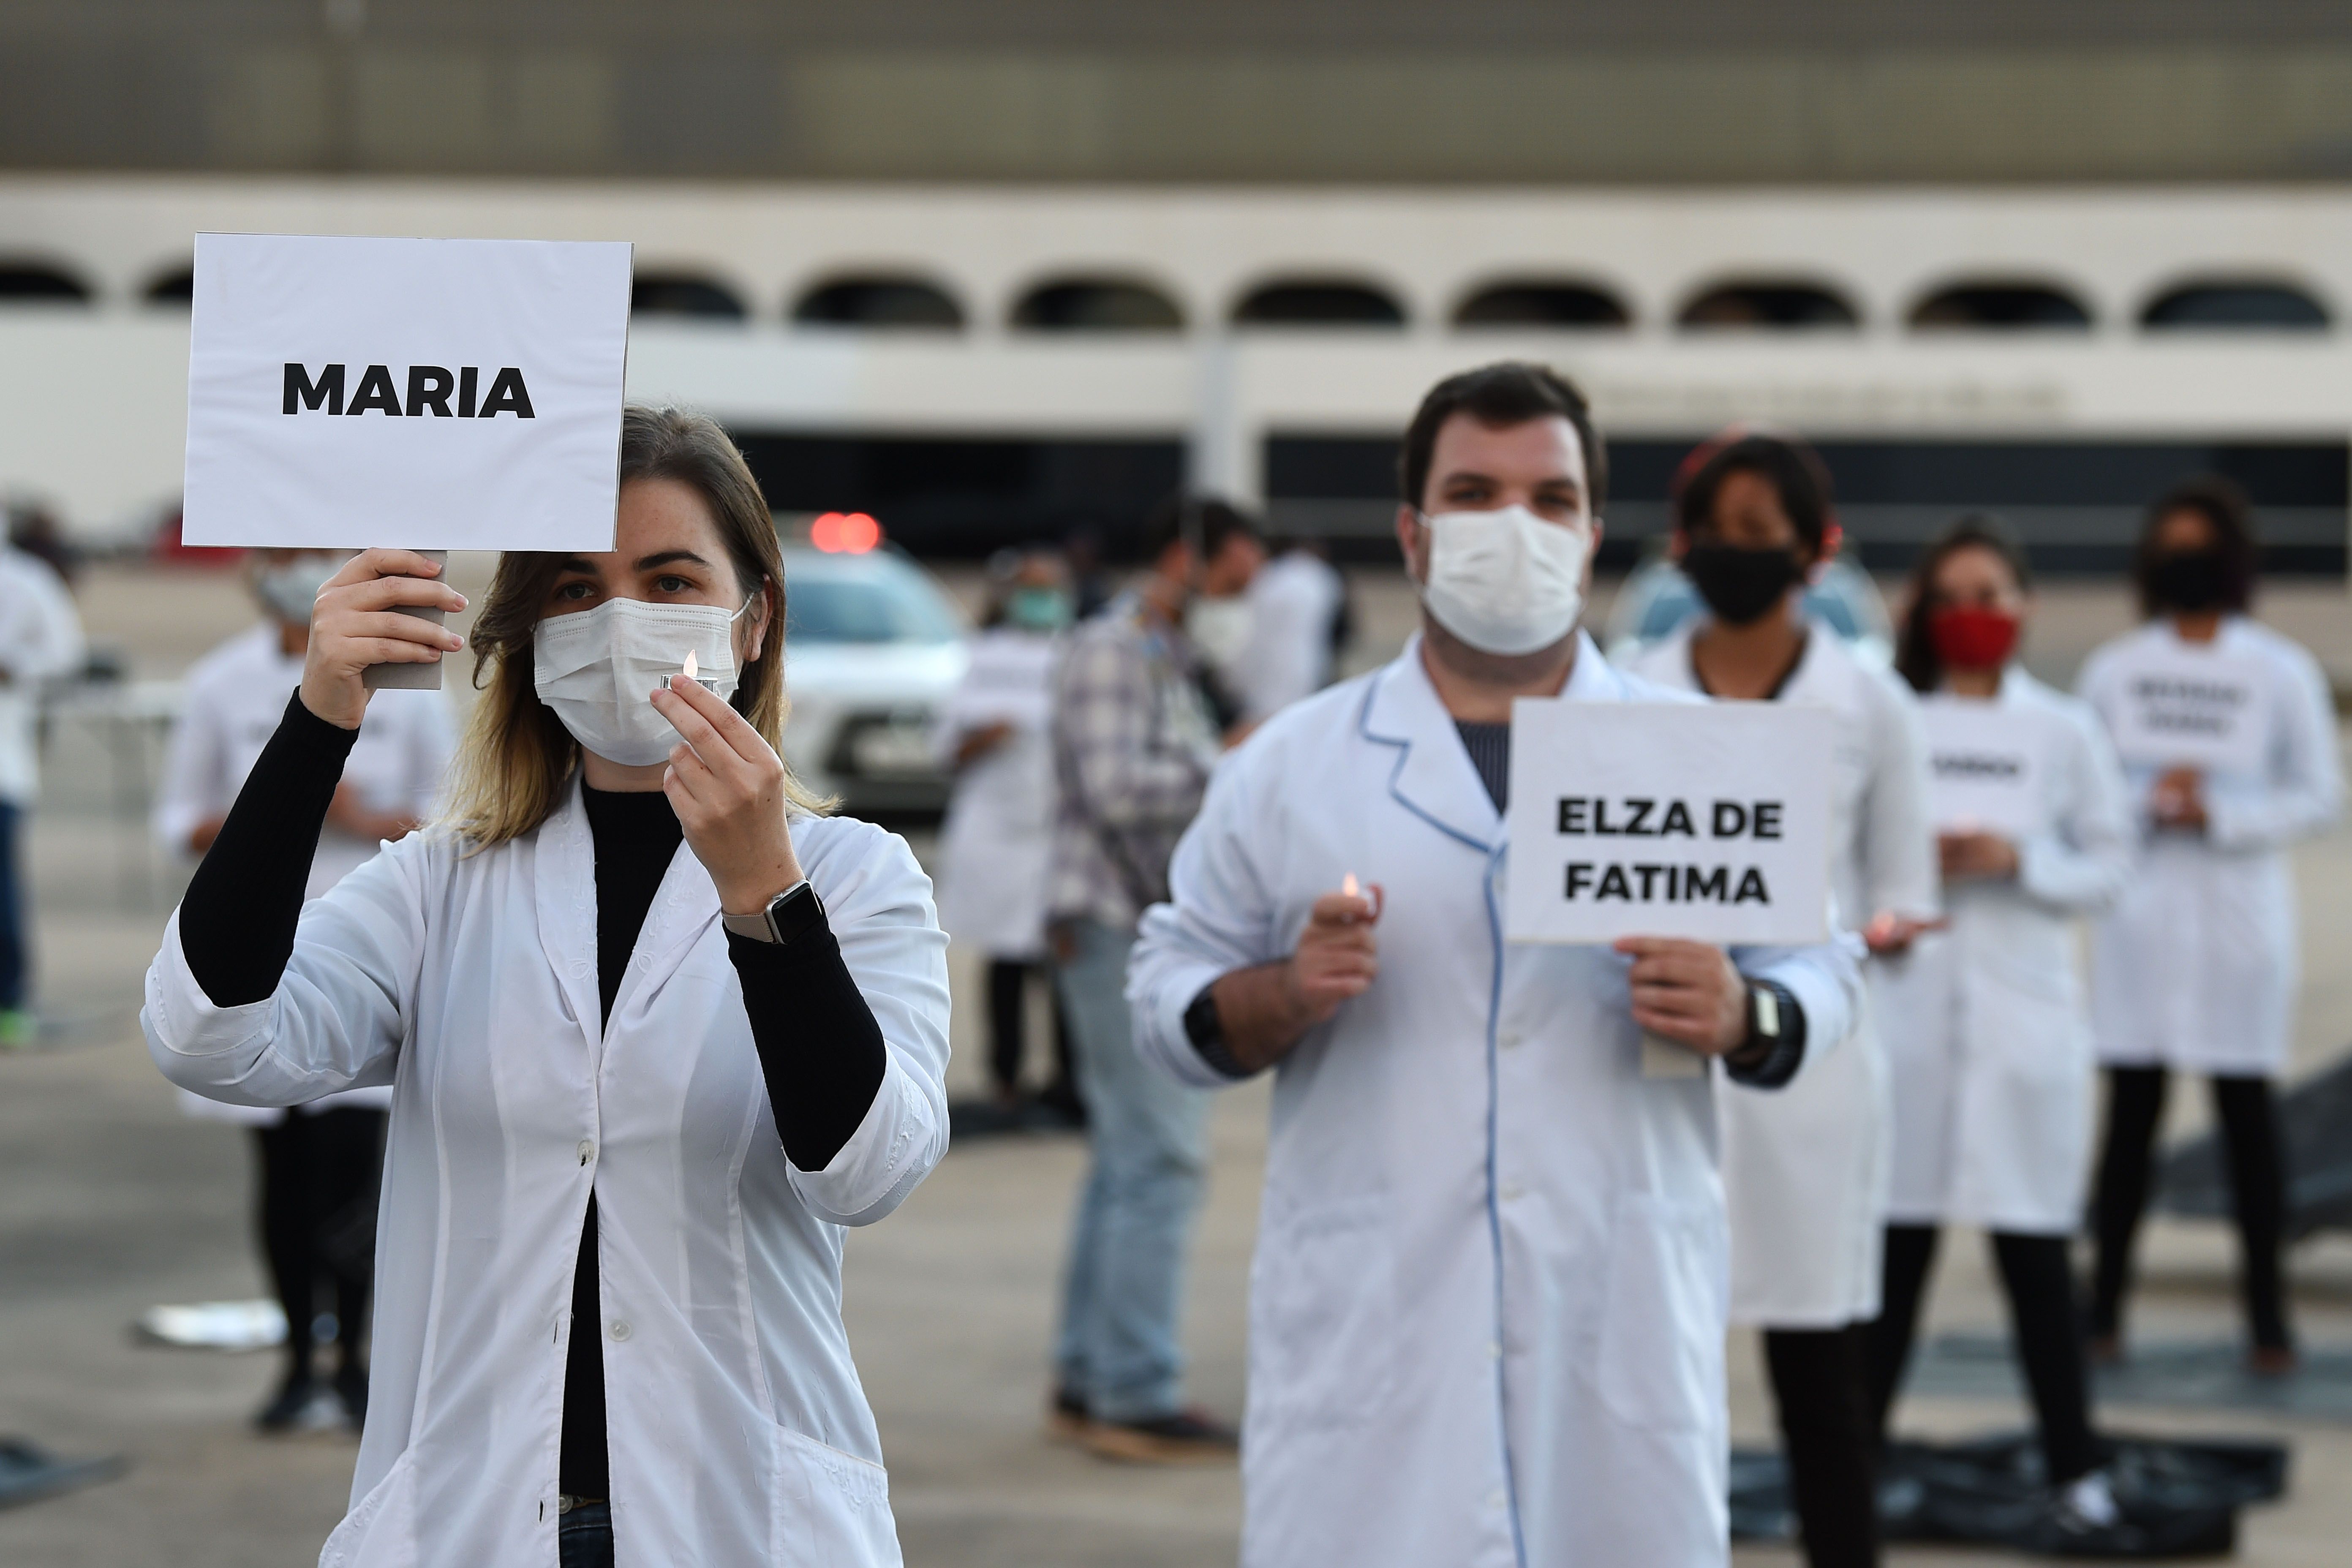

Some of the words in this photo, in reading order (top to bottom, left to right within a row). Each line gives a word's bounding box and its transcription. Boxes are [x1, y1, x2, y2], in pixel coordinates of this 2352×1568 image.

[282, 362, 536, 419] MARIA
[1557, 797, 1696, 837] ELZA
[1711, 801, 1782, 840] DE
[1564, 863, 1769, 904] FATIMA
